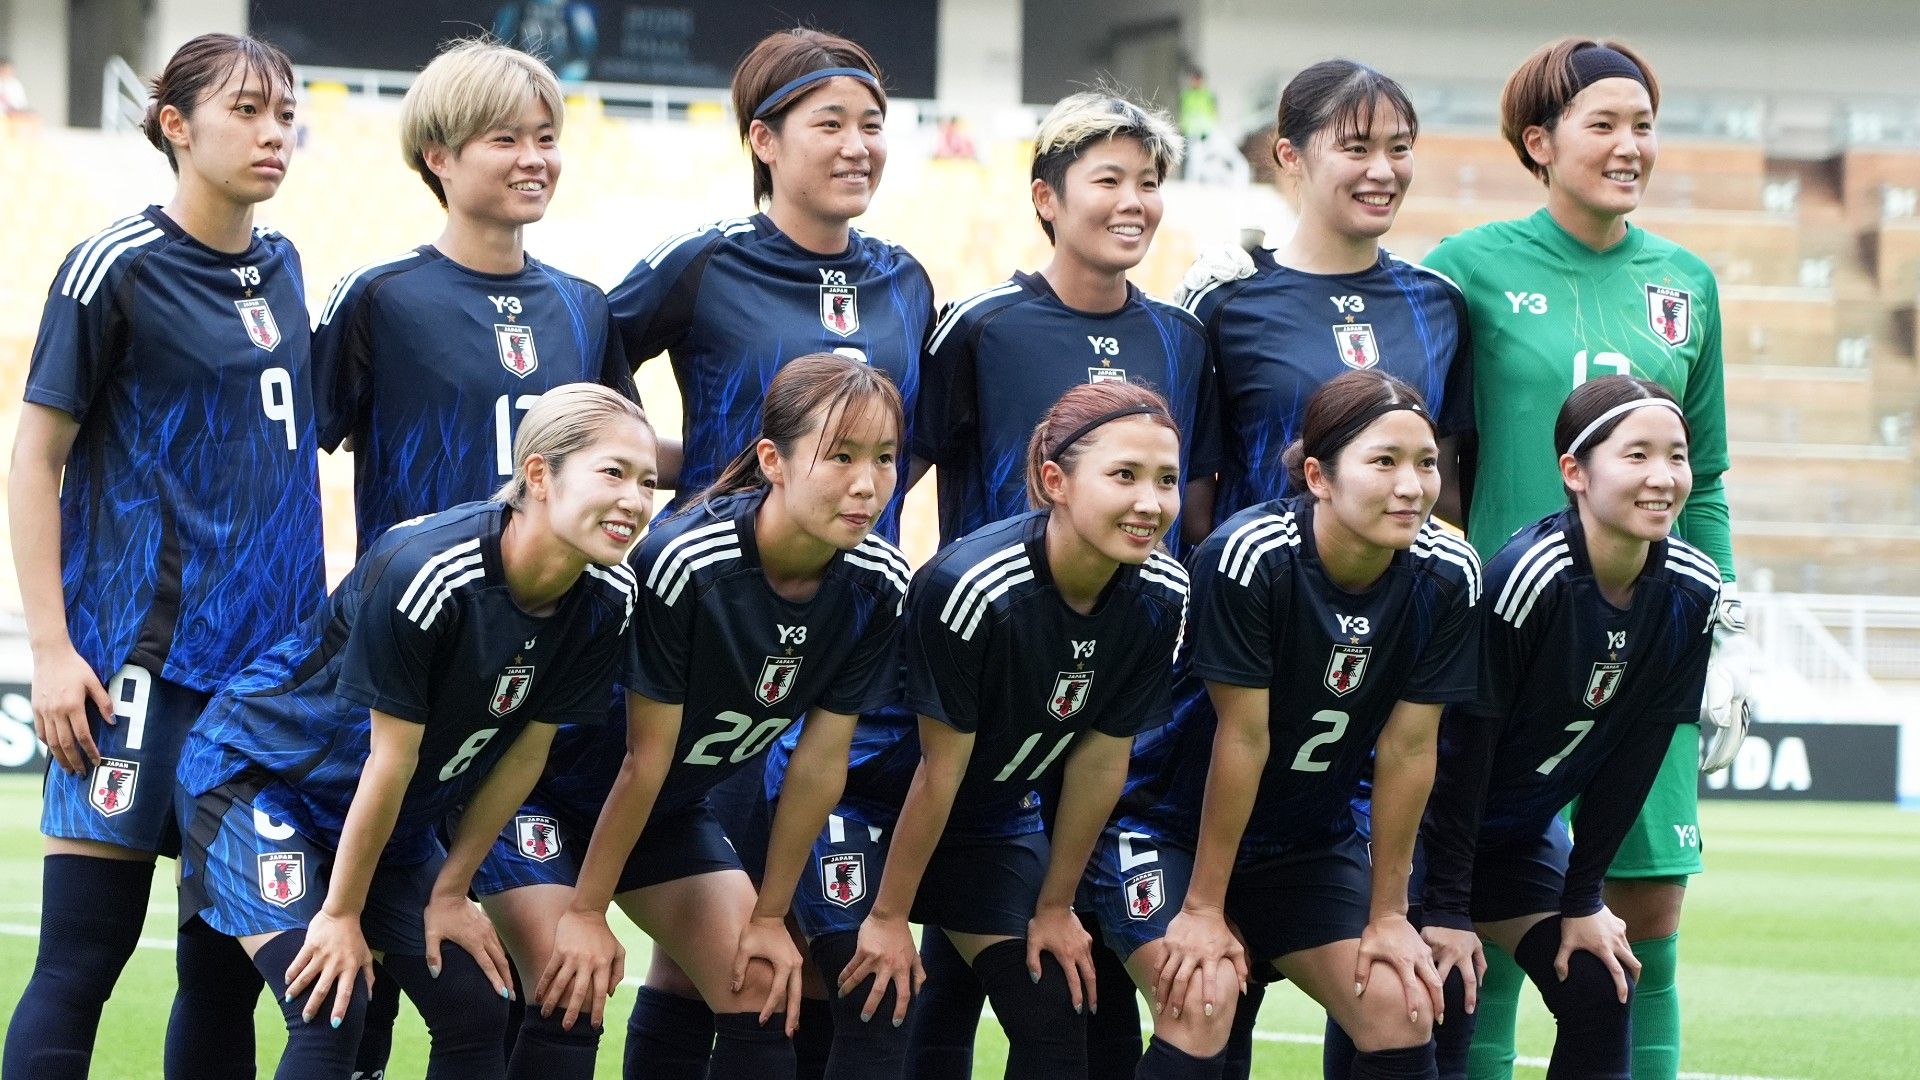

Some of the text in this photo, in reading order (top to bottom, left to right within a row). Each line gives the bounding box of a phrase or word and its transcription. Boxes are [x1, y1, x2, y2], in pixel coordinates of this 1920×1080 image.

[230, 266, 261, 287] Y-3
[487, 295, 523, 314] Y-3
[1329, 295, 1365, 313] Y-3
[1504, 291, 1548, 315] Y-3
[1656, 288, 1680, 297] JAPAN
[1087, 335, 1120, 355] Y-3
[260, 367, 297, 450] 9
[496, 394, 542, 475] 1
[776, 623, 808, 645] Y-3
[1335, 613, 1370, 635] Y-3
[1071, 639, 1097, 659] Y-3
[108, 663, 152, 749] 9
[682, 710, 792, 766] 20
[1290, 709, 1350, 772] 2
[1536, 720, 1595, 775] 7
[439, 728, 500, 781] 8
[993, 732, 1076, 781] 11
[1673, 824, 1697, 848] Y-3
[1132, 872, 1153, 883] JAPAN
